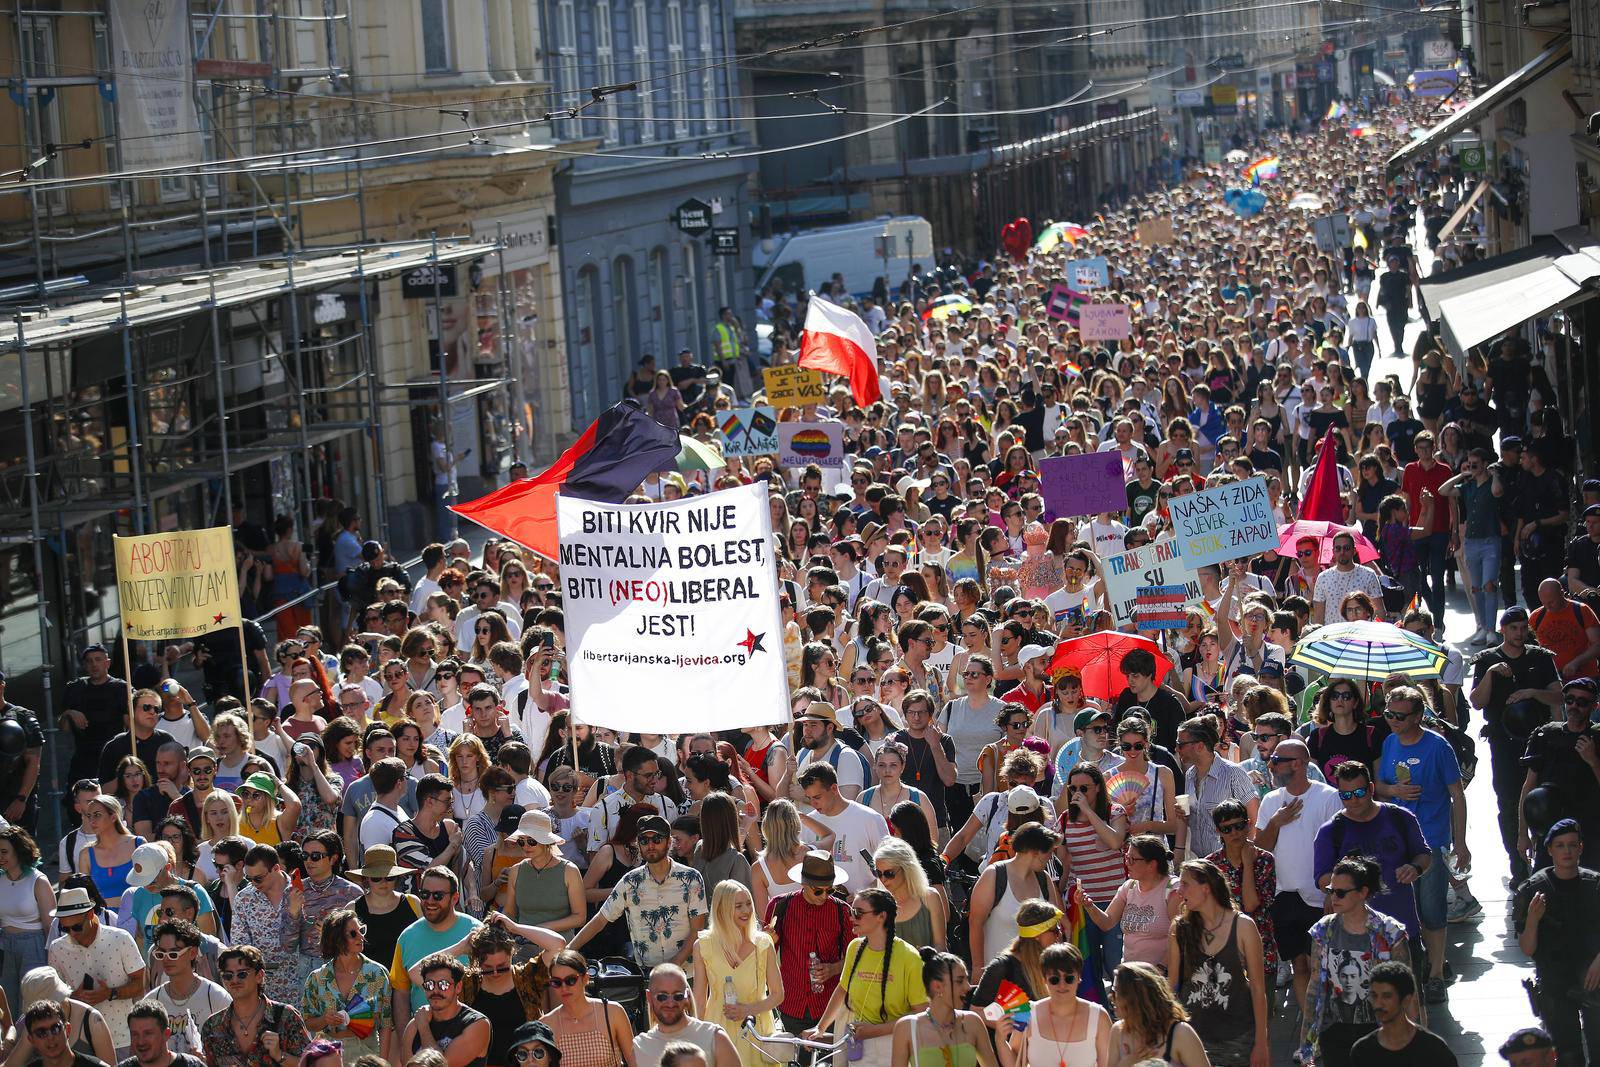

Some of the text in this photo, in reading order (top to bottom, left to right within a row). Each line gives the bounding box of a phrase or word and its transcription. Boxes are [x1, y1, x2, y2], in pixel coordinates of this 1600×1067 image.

[408, 274, 449, 286] adids
[1173, 494, 1220, 520] NAŠA
[1220, 491, 1228, 507] 4
[1240, 503, 1267, 523] JUG,
[582, 505, 737, 534] BITI KVIR NIJE
[1229, 521, 1273, 546] ZAPAD!
[560, 538, 766, 569] MENTALNA BOLEST,
[1109, 540, 1181, 575] TRANS PRAV
[1143, 567, 1165, 586] SU
[568, 576, 760, 607] BITI (NEO)LIBERAL
[636, 614, 696, 637] JEST!
[583, 649, 746, 668] libertarijanska-ljevica.org
